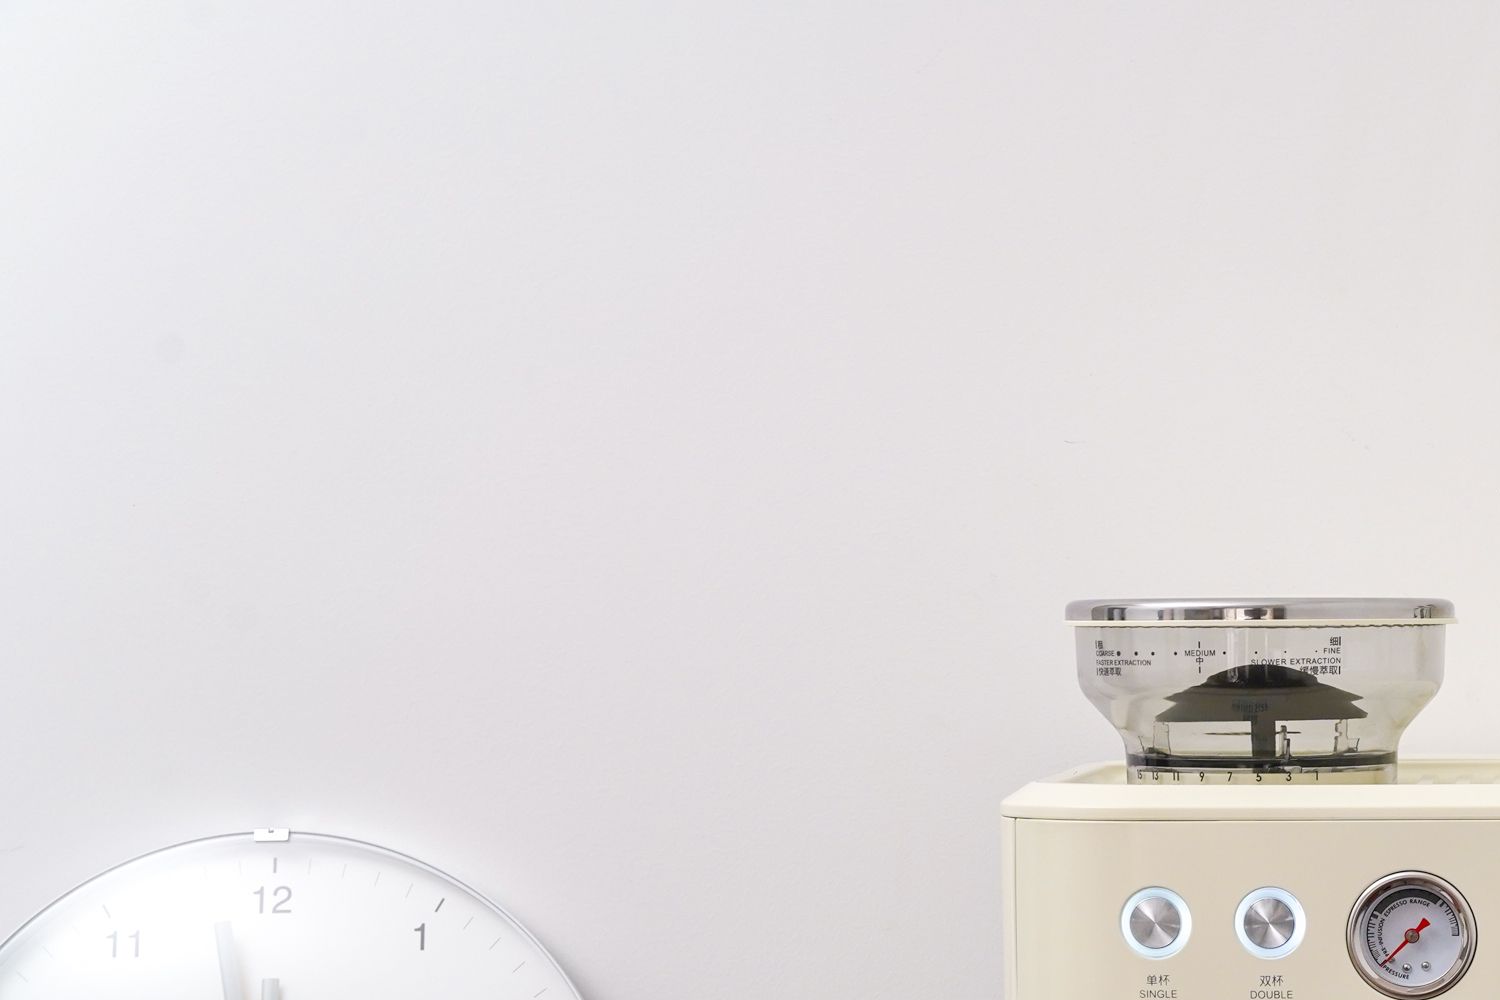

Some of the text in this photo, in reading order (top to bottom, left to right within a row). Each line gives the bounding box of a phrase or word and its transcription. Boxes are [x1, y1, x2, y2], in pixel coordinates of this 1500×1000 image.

[1251, 657, 1341, 666] SLOWER EXTRACTION
[1151, 771, 1159, 781] 13
[1172, 771, 1180, 781] 11
[1199, 771, 1205, 782] 9
[1227, 772, 1233, 782] 7
[1255, 772, 1262, 782] 5
[1285, 771, 1292, 782] 3
[1314, 771, 1319, 781] 1
[253, 886, 292, 914] 12
[1383, 898, 1431, 917] ESPRESSO RANGE
[414, 923, 426, 950] 1
[106, 930, 140, 958] 11
[1382, 964, 1410, 980] PRESSURE
[1146, 974, 1171, 986] 单杯
[1259, 974, 1284, 987] 双杯
[1139, 989, 1177, 999] SINGLE
[1250, 989, 1294, 1000] DOUBLE
